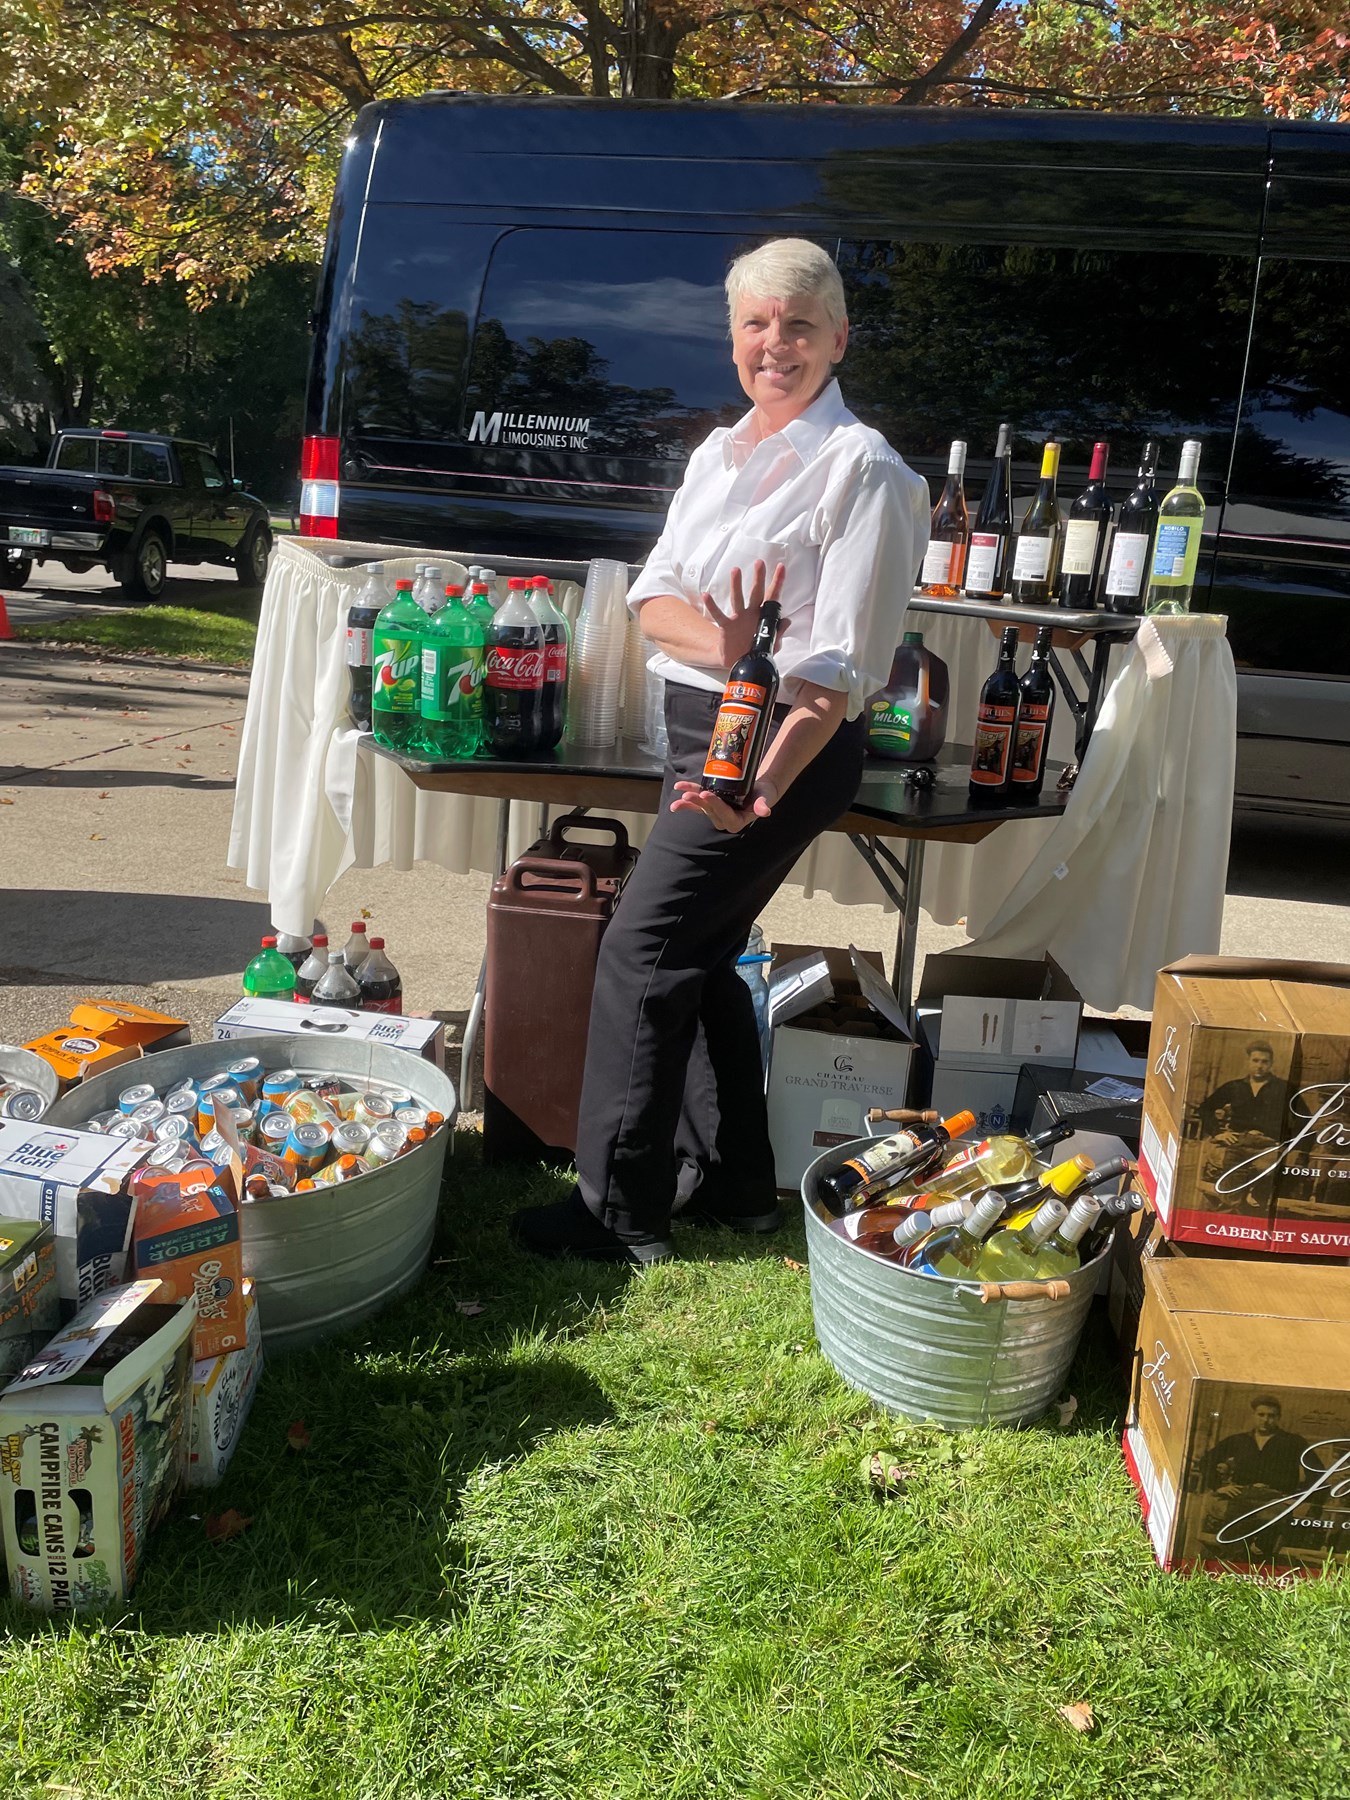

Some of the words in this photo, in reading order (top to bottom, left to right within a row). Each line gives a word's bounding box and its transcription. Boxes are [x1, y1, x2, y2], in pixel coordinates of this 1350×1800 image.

[468, 411, 590, 443] MILLENNIUM
[502, 431, 567, 448] LIMOUSINES
[569, 436, 589, 449] INC
[369, 1029, 399, 1040] LIGHT
[67, 1055, 84, 1066] PAC
[785, 1075, 829, 1089] GRAND
[830, 1080, 894, 1096] TRAVERSE
[816, 1071, 865, 1082] CHATEAU
[5, 1153, 58, 1170] LIGHT
[16, 1142, 65, 1161] Blue
[1282, 1165, 1322, 1178] JOSH
[44, 1188, 54, 1221] PORTED
[1204, 1223, 1296, 1244] CABERNET
[149, 1230, 230, 1262] ARBOR
[78, 1260, 94, 1306] LIGH
[221, 1334, 238, 1348] 6
[1142, 1340, 1177, 1406] Josh
[40, 1422, 62, 1509] CAMPFIRE
[1290, 1518, 1336, 1529] JOSH
[43, 1514, 65, 1554] CANS
[48, 1561, 68, 1576] 12
[51, 1580, 72, 1611] PAC
